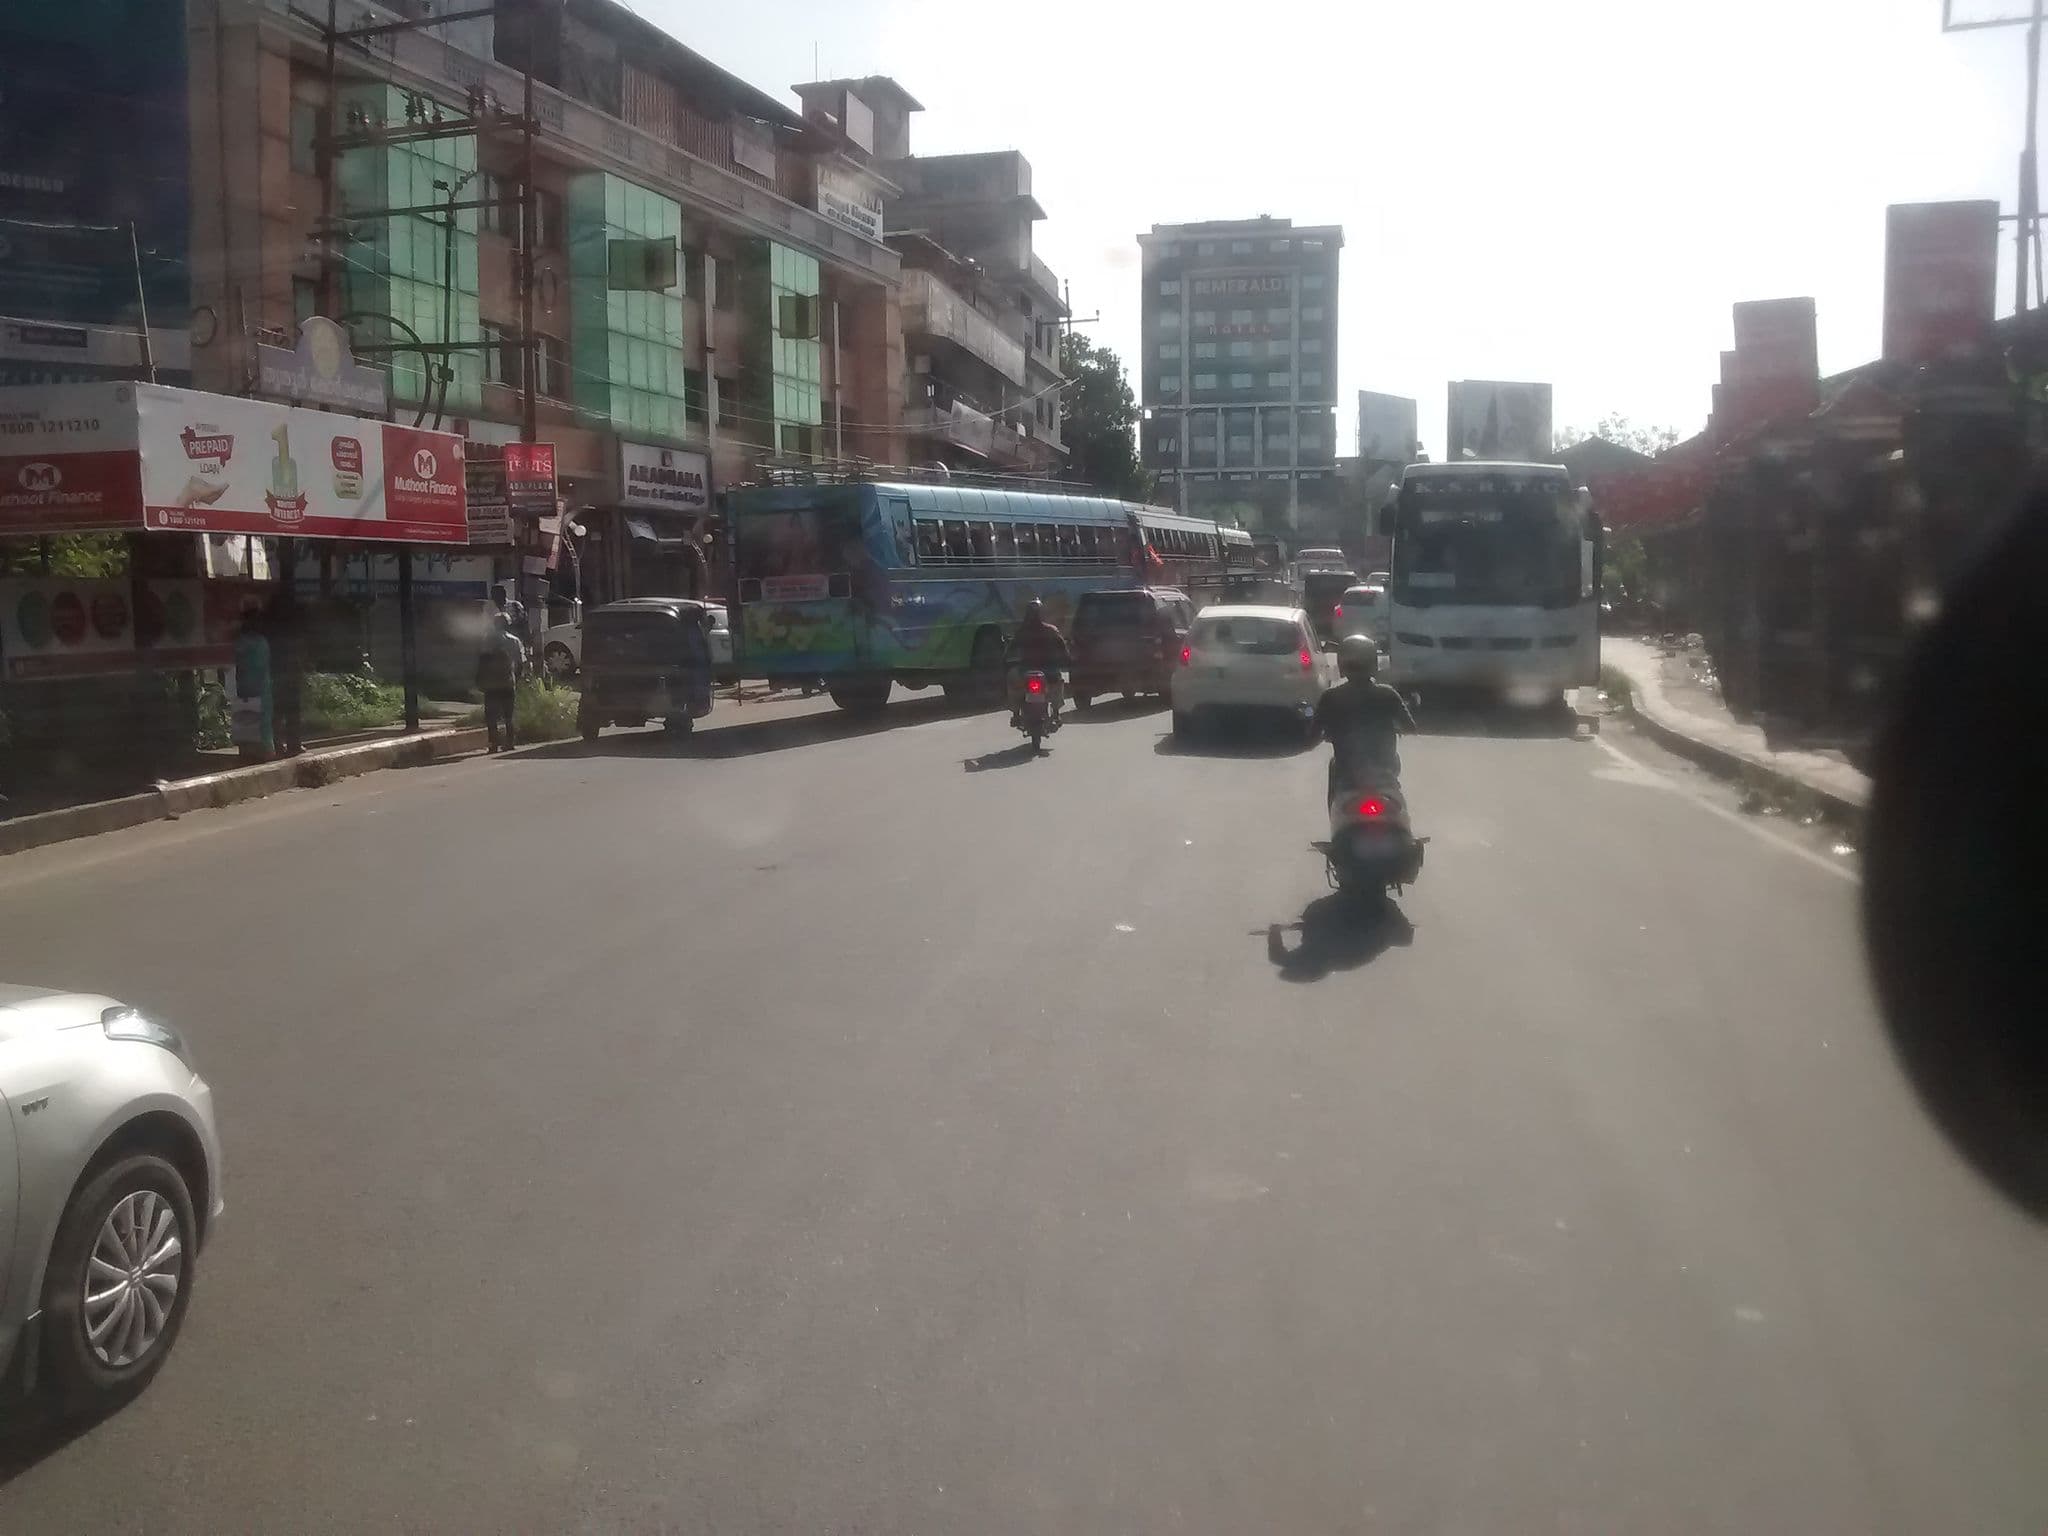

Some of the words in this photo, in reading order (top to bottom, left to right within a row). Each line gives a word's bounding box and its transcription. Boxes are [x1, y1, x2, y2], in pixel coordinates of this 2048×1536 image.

[189, 439, 229, 455] PREPAID
[200, 463, 219, 474] LOAN
[395, 476, 429, 493] Muthoot
[429, 480, 457, 496] Finance
